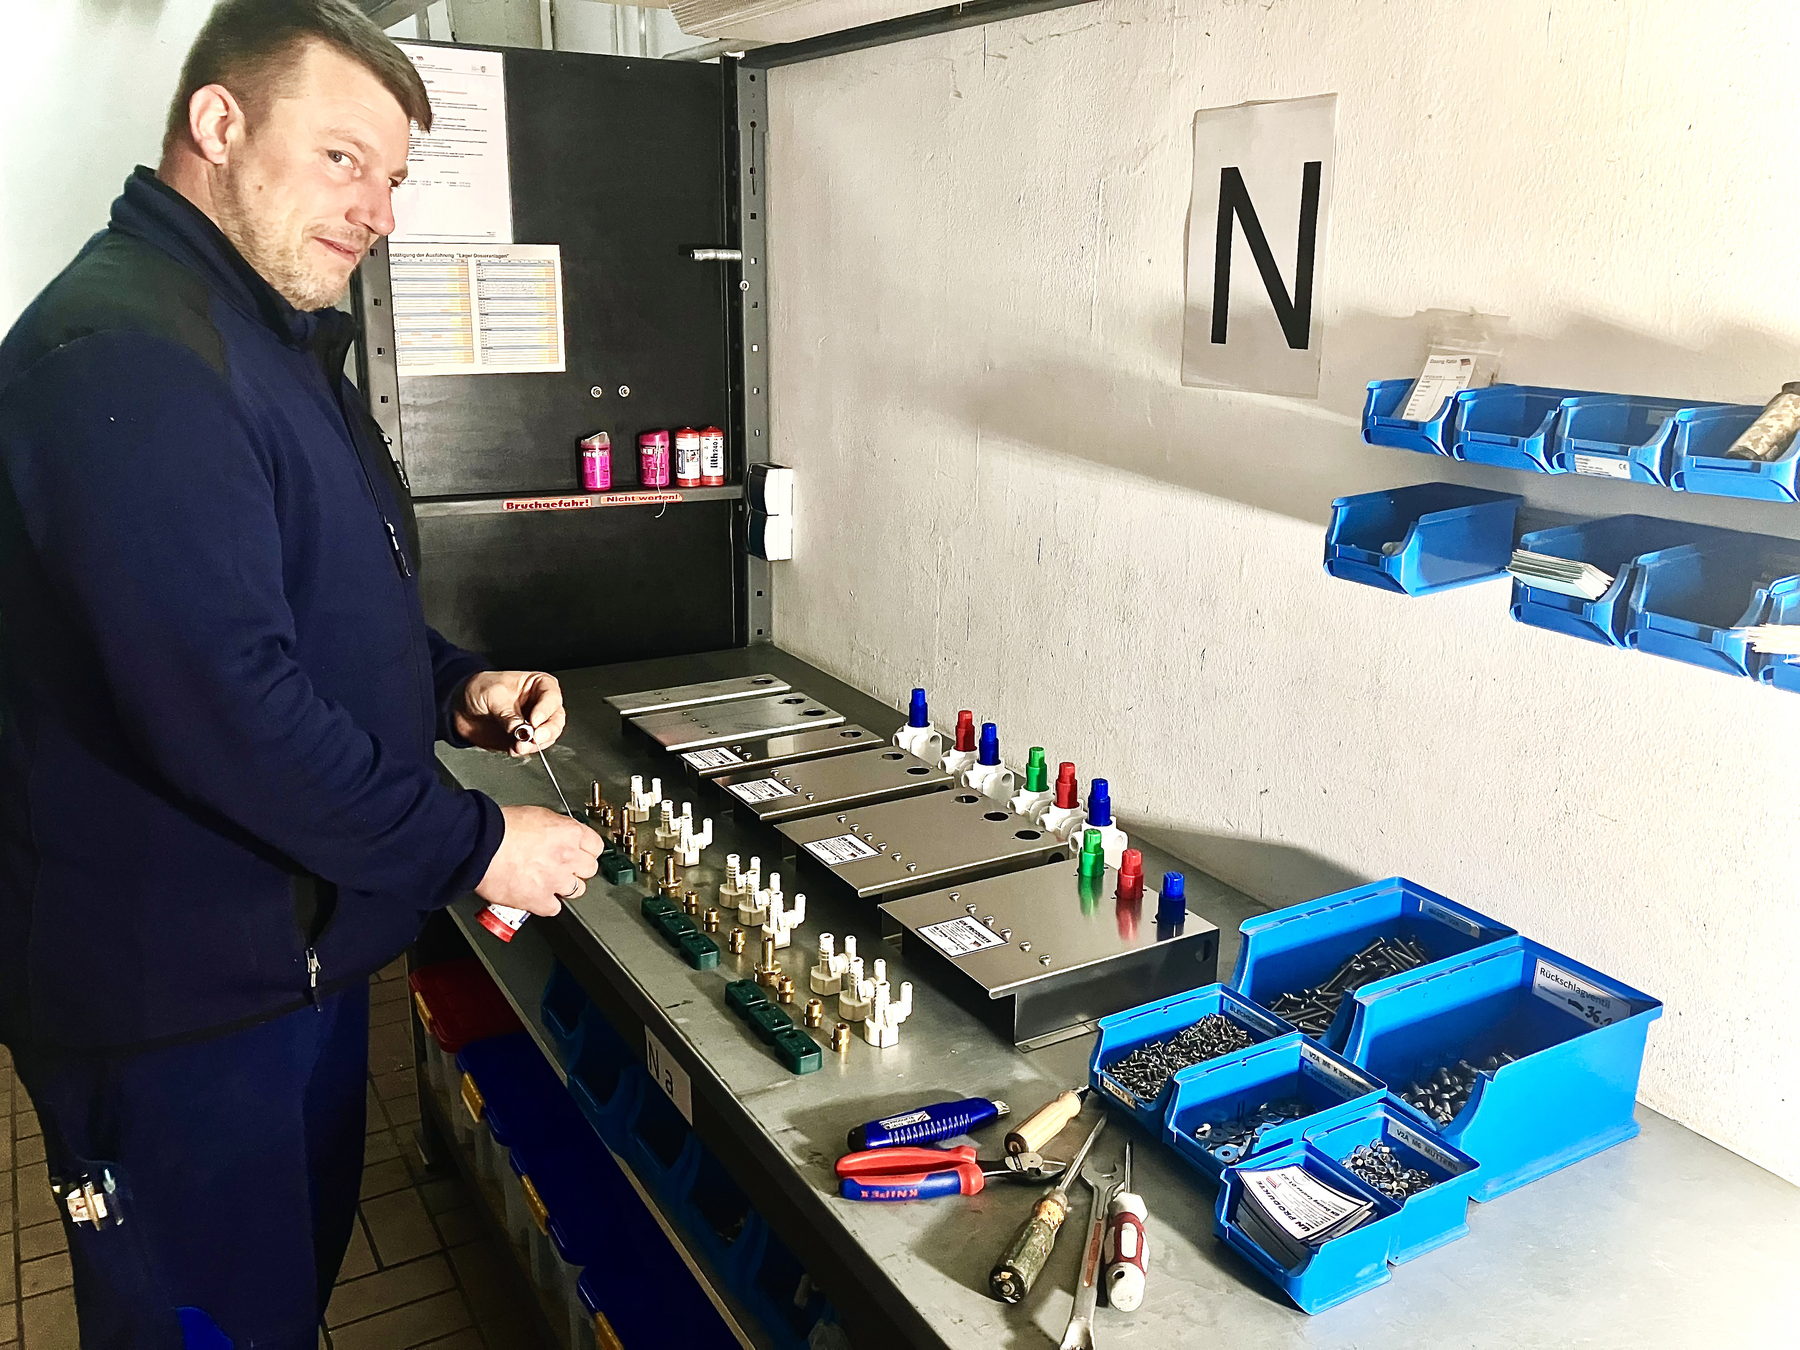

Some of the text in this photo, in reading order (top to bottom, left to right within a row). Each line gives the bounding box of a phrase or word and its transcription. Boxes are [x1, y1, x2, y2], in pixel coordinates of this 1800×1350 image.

[1211, 161, 1322, 350] N
[606, 495, 635, 503] Nicht
[1540, 967, 1611, 1009] Rückschlagventil
[1396, 1129, 1409, 1141] V2A
